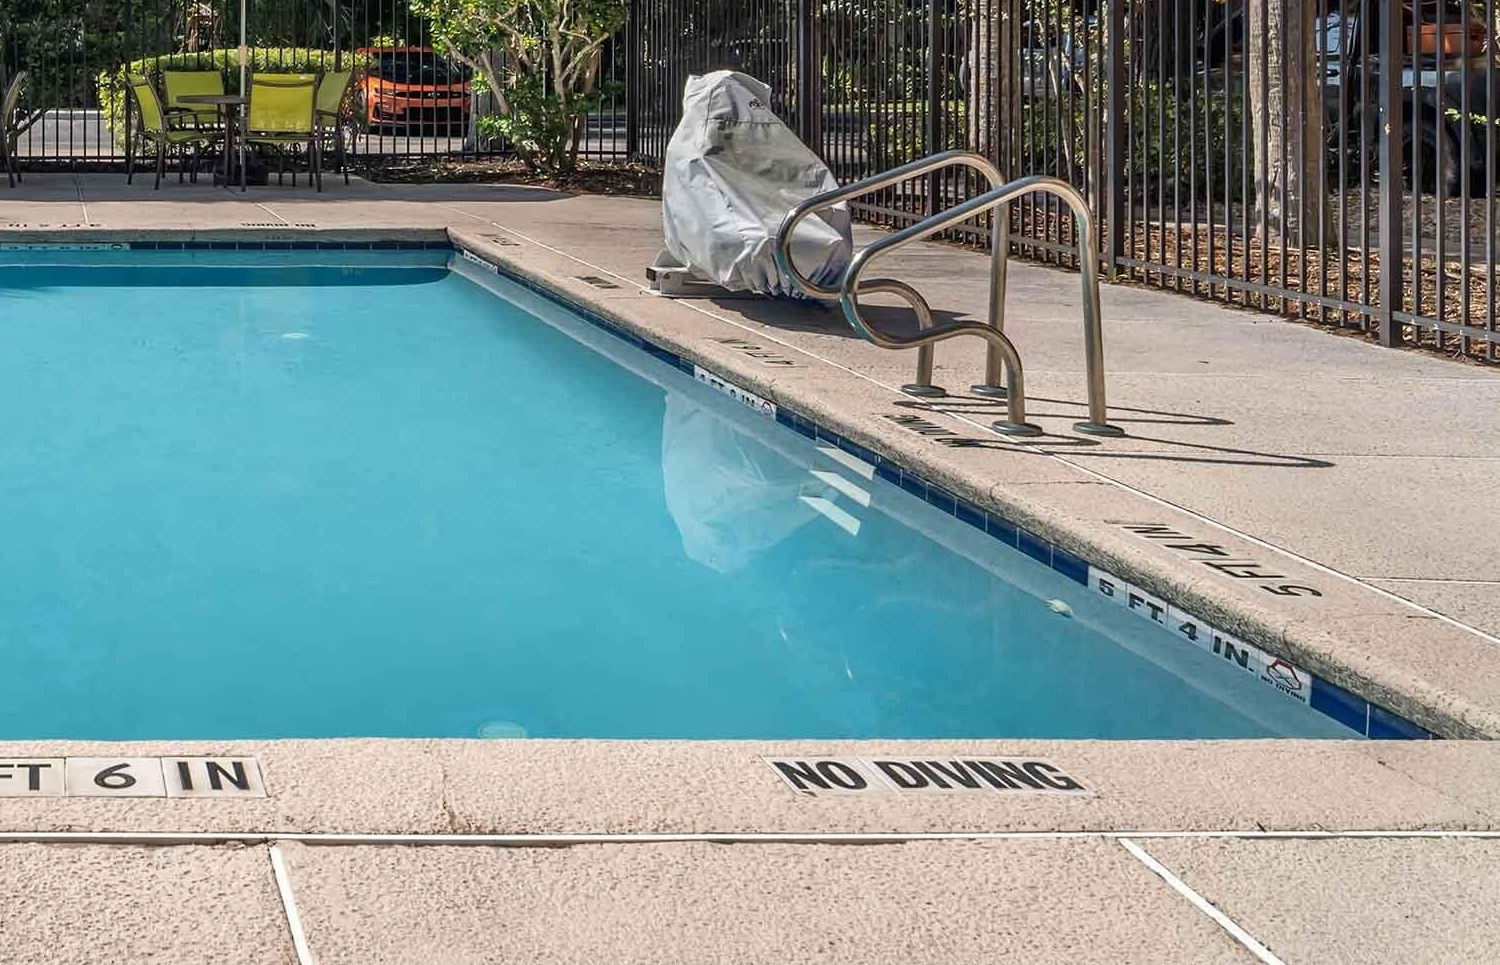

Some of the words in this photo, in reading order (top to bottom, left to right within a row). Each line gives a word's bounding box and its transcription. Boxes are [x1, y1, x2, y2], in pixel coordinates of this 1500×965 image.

[1122, 526, 1195, 539] IN
[1164, 544, 1230, 556] 4
[1201, 561, 1285, 578] FT
[1259, 585, 1323, 597] 5
[1099, 578, 1115, 597] 5
[1128, 593, 1164, 624] FT.
[1179, 621, 1199, 642] 4
[1212, 635, 1255, 673] IN.
[93, 763, 137, 789] 6
[177, 761, 251, 790] IN
[772, 761, 868, 790] NO
[872, 761, 1086, 791] DIVING
